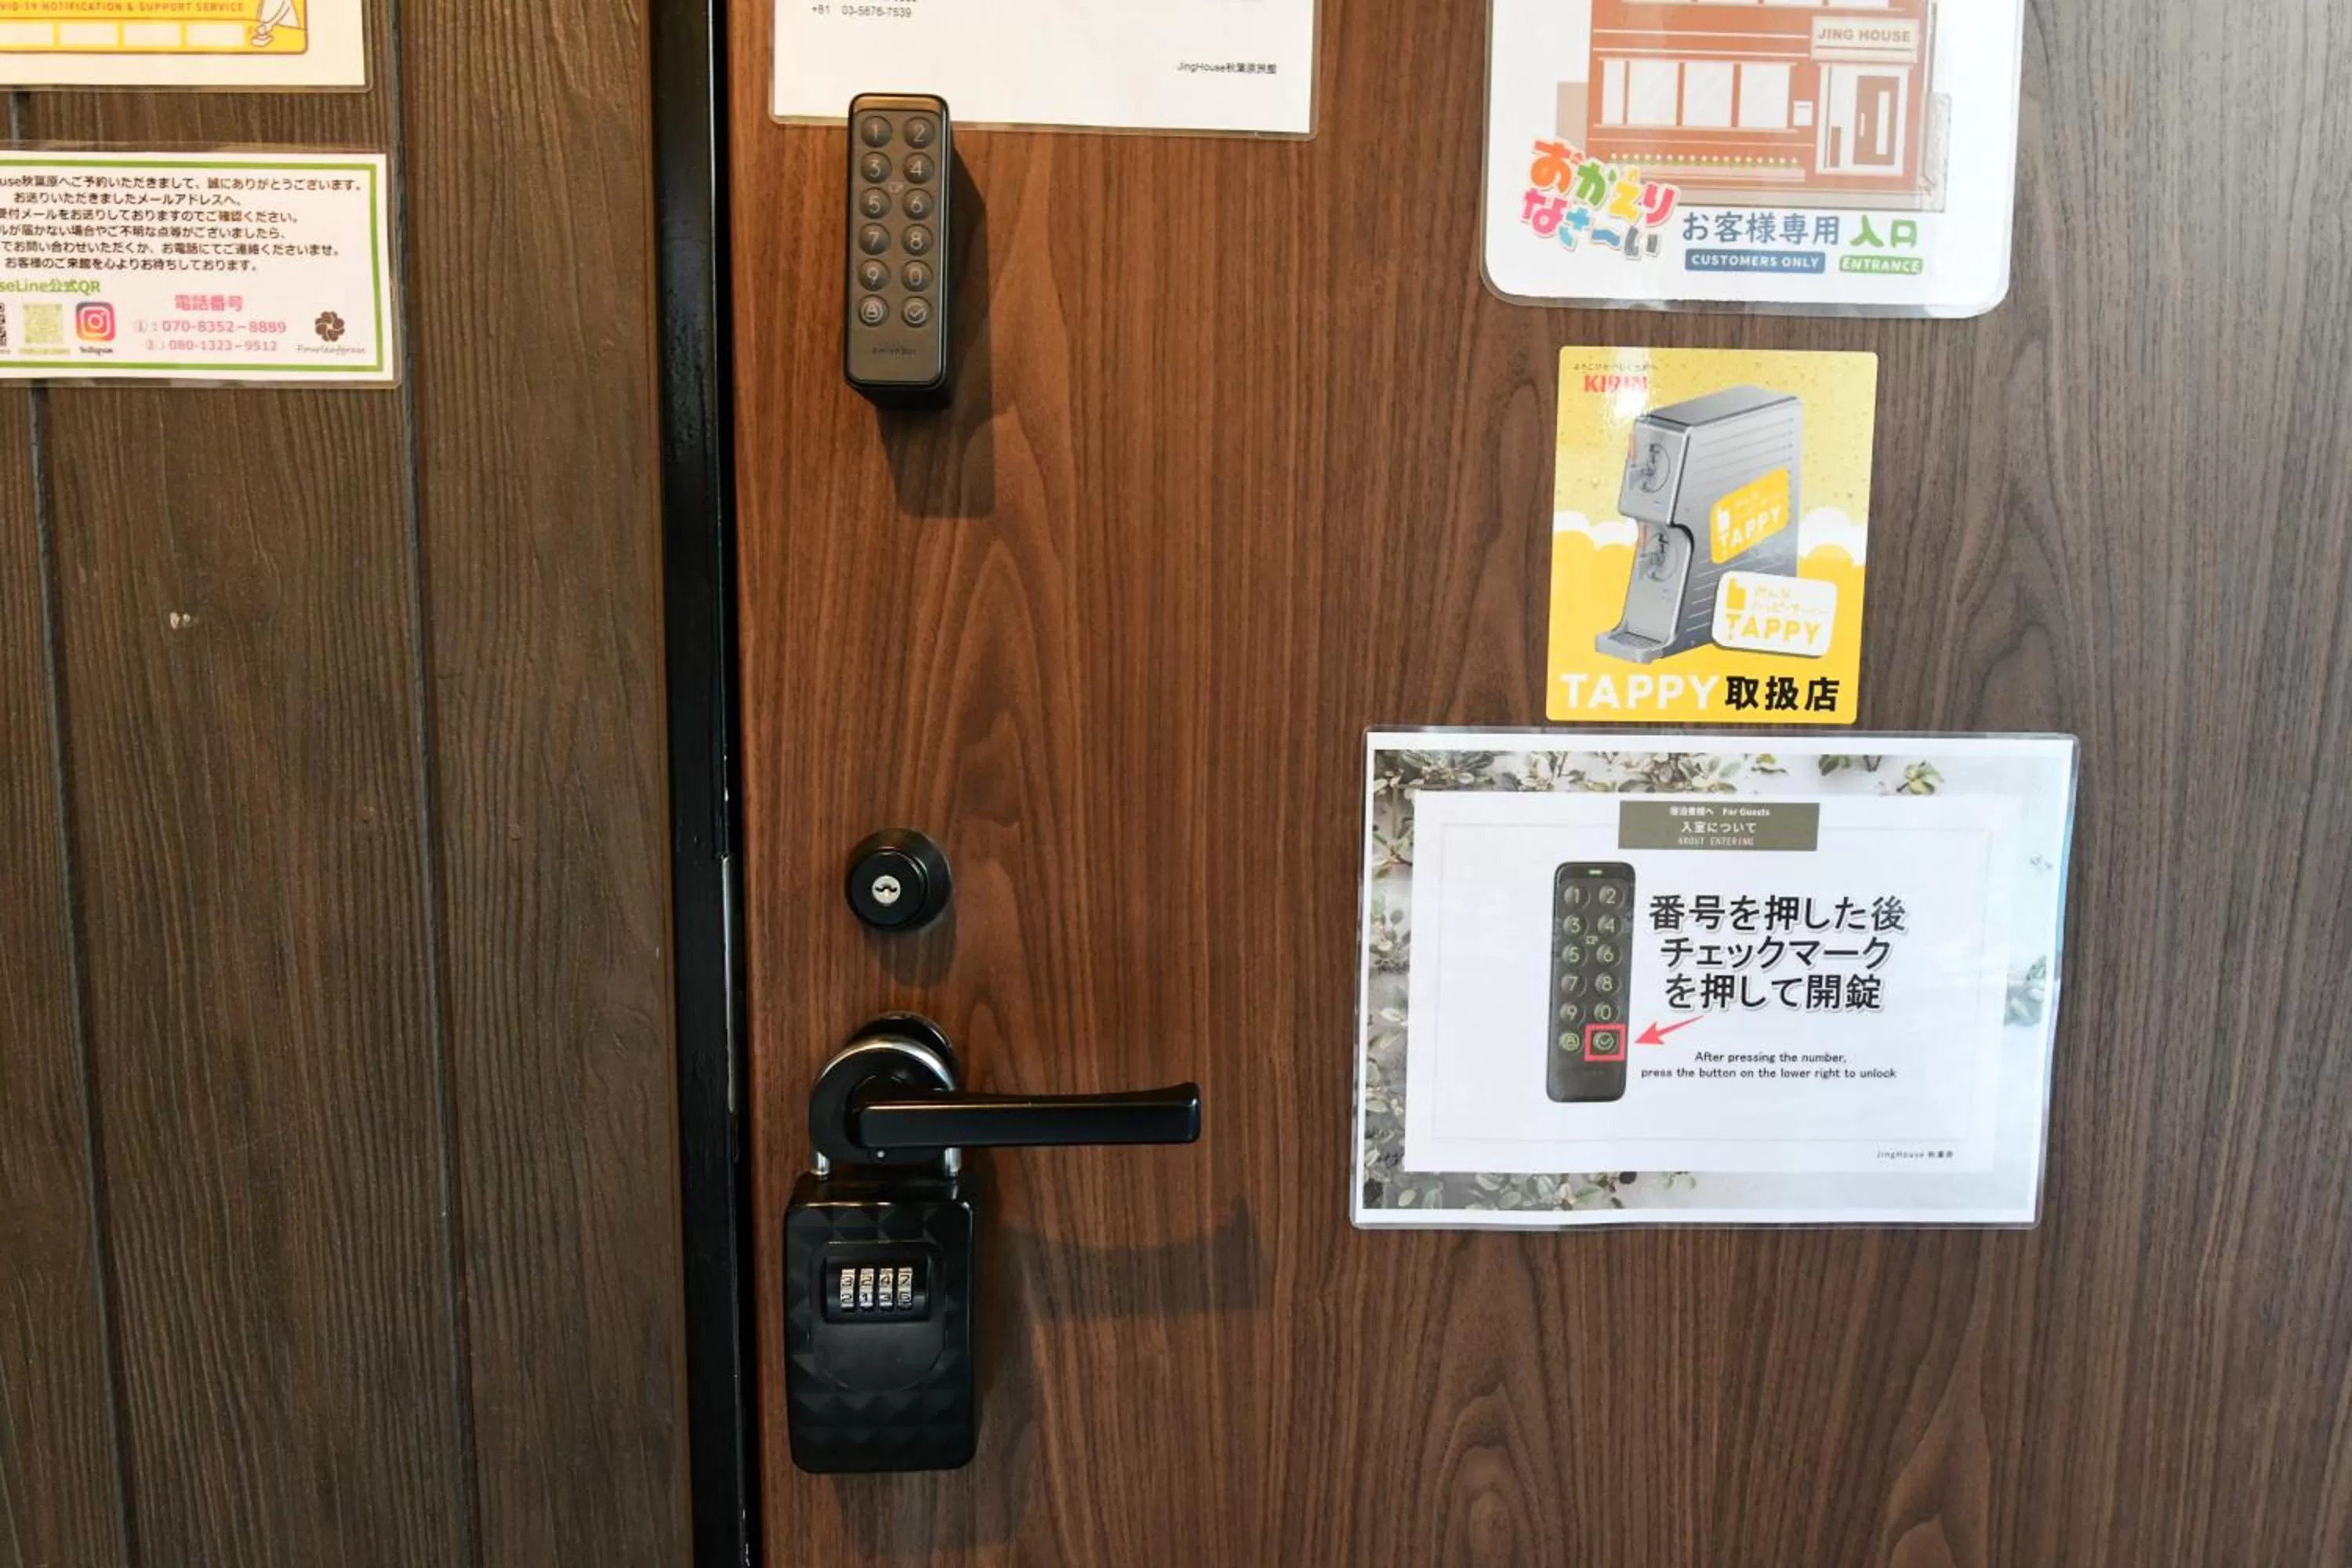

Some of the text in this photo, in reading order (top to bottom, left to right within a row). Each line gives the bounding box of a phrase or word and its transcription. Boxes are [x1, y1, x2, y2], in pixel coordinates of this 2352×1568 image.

[139, 2, 191, 12] SUPPORT
[196, 2, 245, 12] SERVICE
[1818, 28, 1911, 42] JING HOUSE
[872, 125, 926, 142] 1 2
[869, 159, 924, 177] 3 4
[868, 196, 924, 214] 5 6
[1682, 211, 1918, 249] お客様専用 入口
[868, 231, 923, 250] 7 8
[1691, 253, 1920, 272] CUSTOMERS ONLY ENTRANCE
[867, 267, 922, 286] 9 0
[174, 294, 244, 312] 電話番号
[1719, 504, 1781, 558] TAPPY
[1726, 615, 1820, 645] TAPPY
[1561, 672, 1840, 712] TAPPY 取扱店
[1722, 808, 1737, 816] For
[1739, 808, 1770, 816] Guests
[1681, 821, 1756, 833] 入室について
[1710, 837, 1755, 846] ENTERING
[1573, 887, 1616, 904] 1 2
[1649, 895, 1907, 931] 番号を押した後
[1570, 916, 1615, 933] 3 4
[1570, 947, 1613, 963] 5 6
[1661, 935, 1892, 969] チェックマーク
[1567, 976, 1613, 992] 7 8
[1665, 973, 1882, 1010] を押して開錠
[1567, 1004, 1611, 1020] 9 0
[1694, 1051, 1847, 1065] After pressing the number,
[1641, 1067, 1896, 1080] press the button on the lower right to unlock
